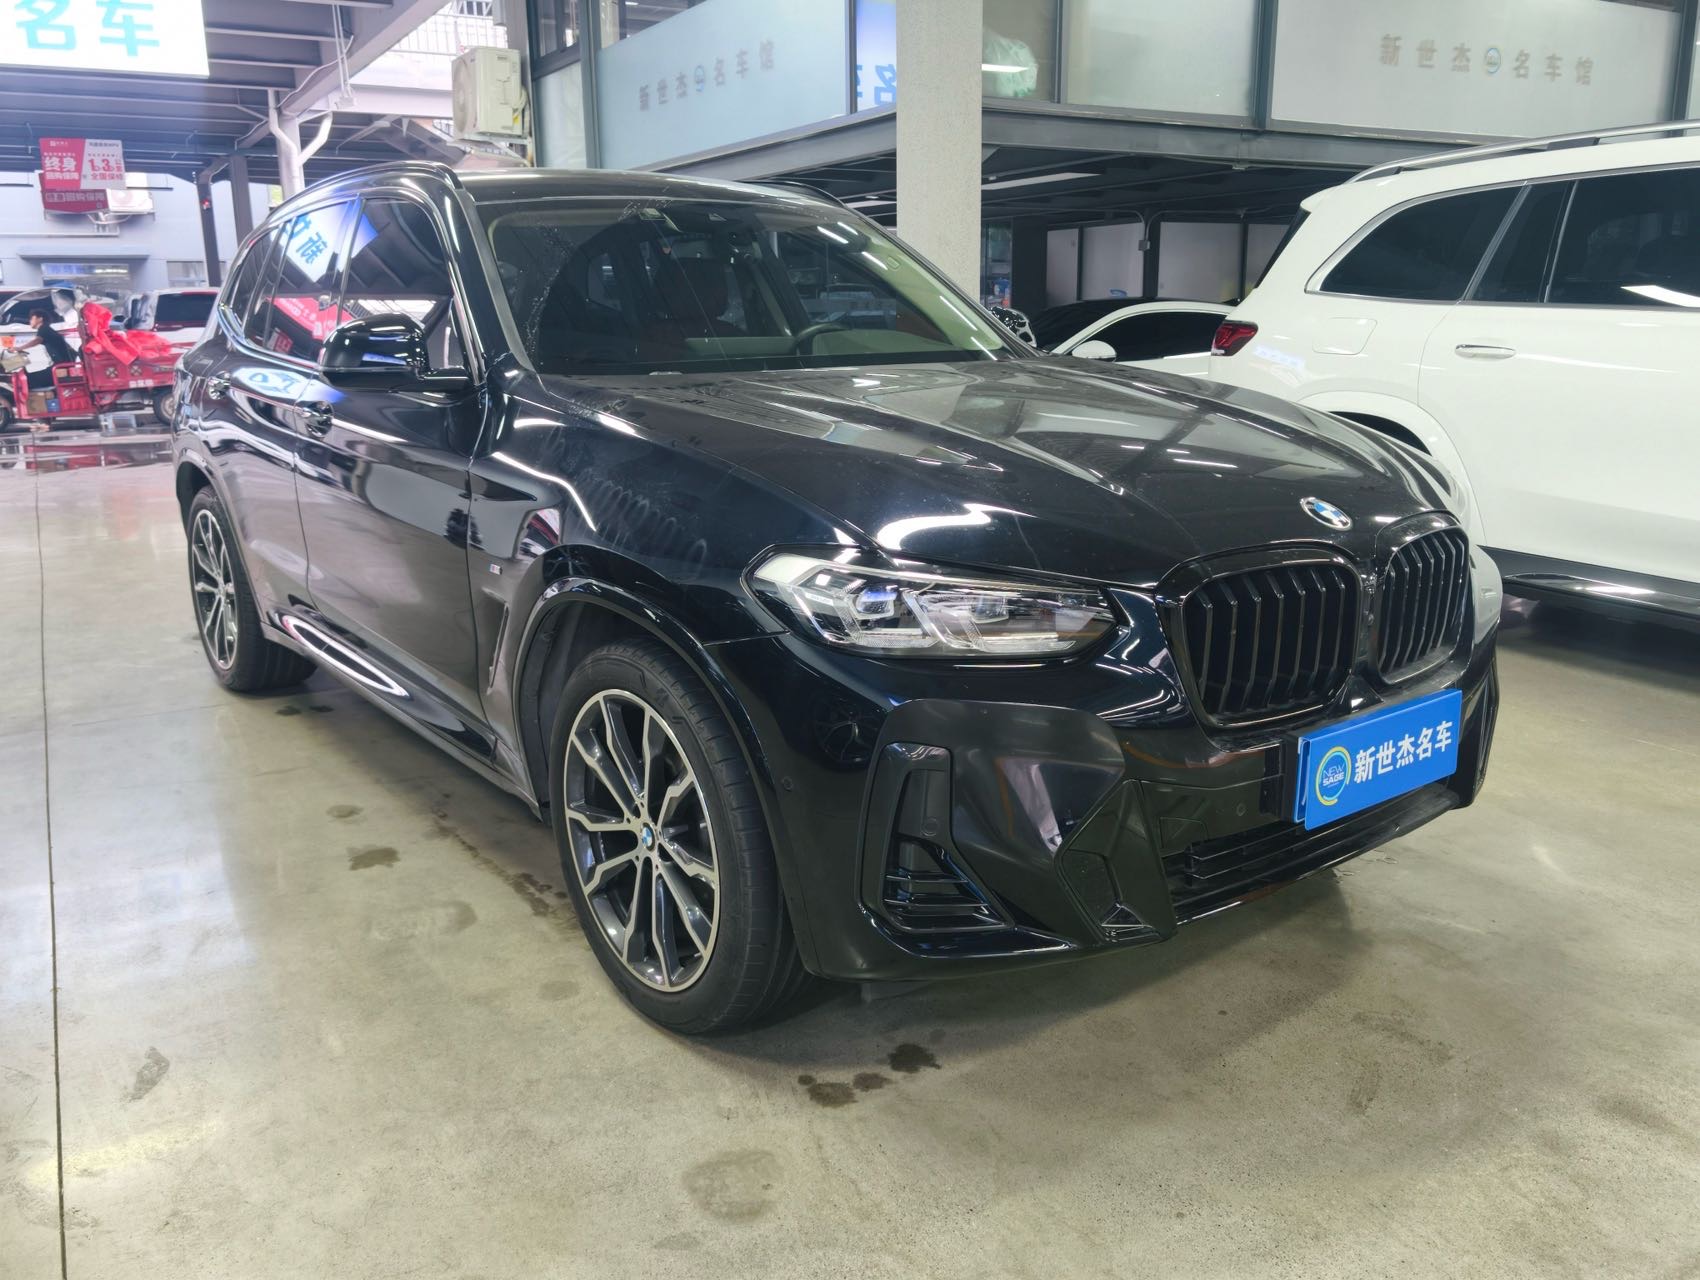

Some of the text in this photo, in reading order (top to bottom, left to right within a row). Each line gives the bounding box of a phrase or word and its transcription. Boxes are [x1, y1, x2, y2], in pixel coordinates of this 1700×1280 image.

[14, 0, 160, 56] 名车
[1380, 34, 1471, 73] 新世杰
[1513, 50, 1593, 86] 名车馆
[44, 157, 76, 171] 终身
[1354, 720, 1453, 784] 新世杰名车
[1322, 772, 1345, 786] SAGE
[1323, 763, 1345, 777] NEW
